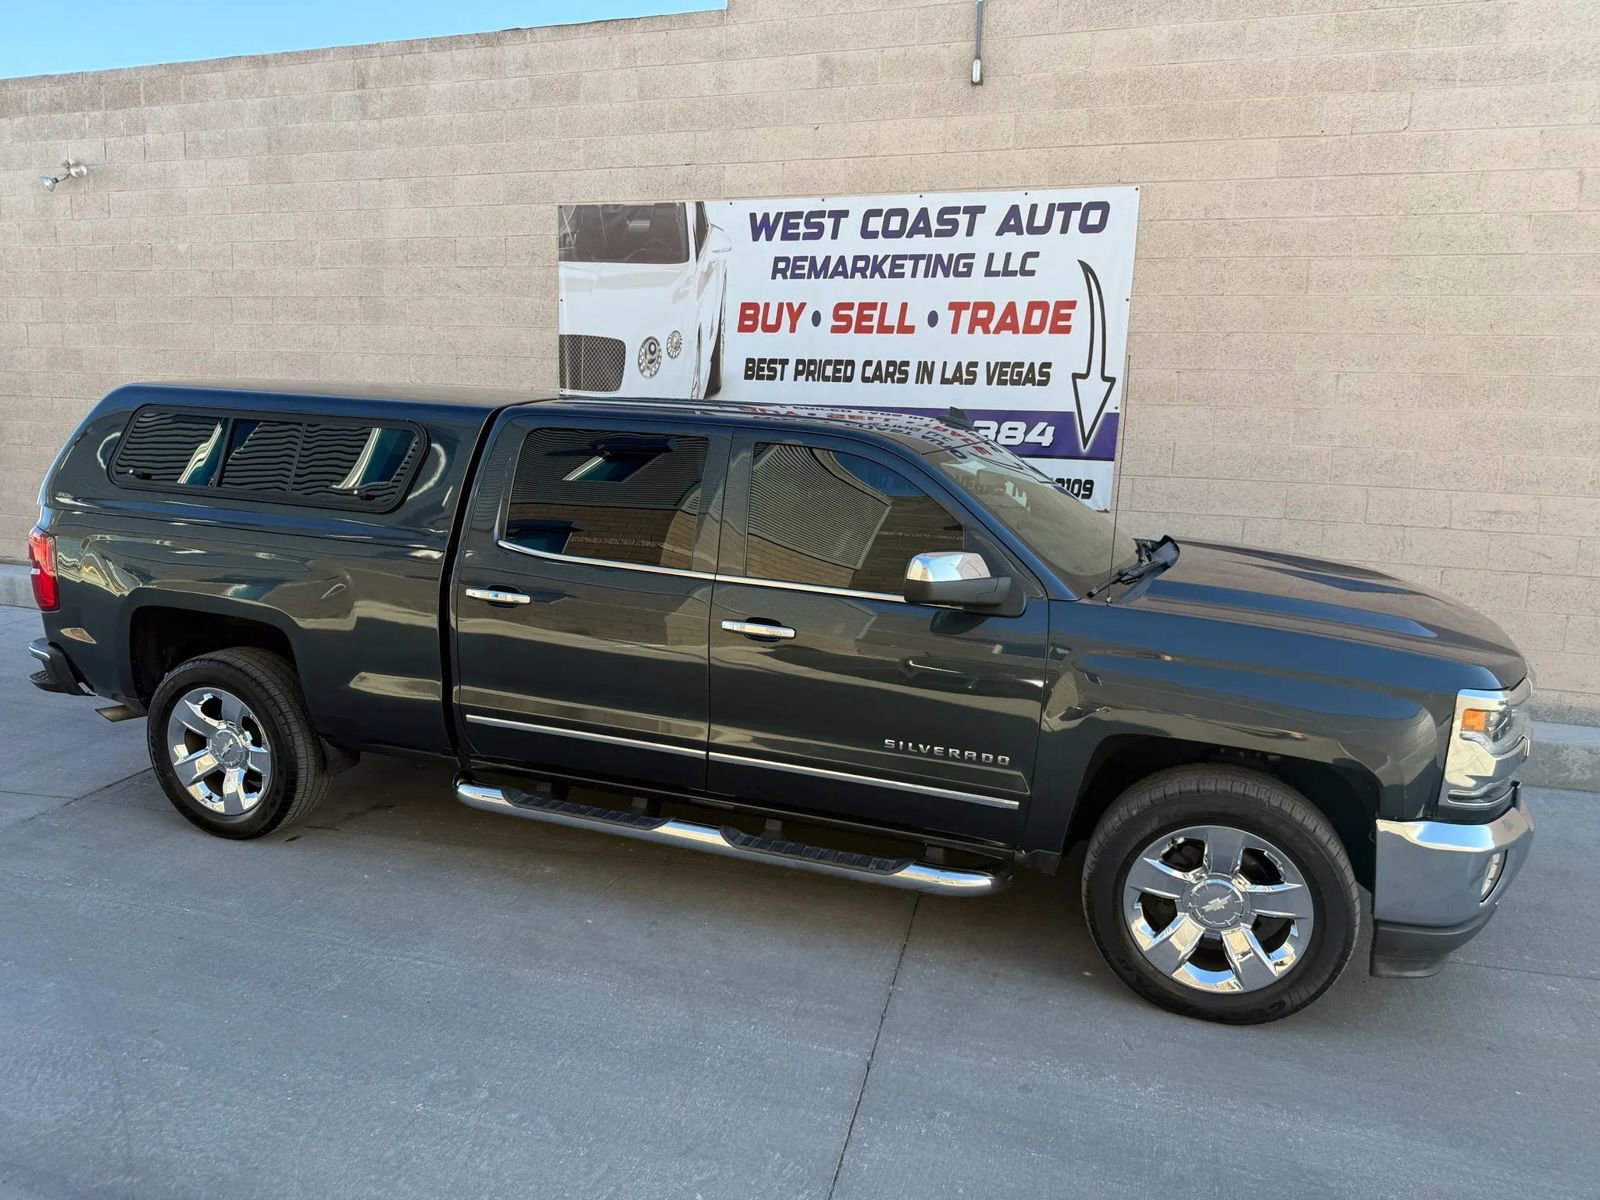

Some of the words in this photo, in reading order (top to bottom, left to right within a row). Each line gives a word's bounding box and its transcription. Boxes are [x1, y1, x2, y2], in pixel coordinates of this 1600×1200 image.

[749, 209, 849, 242] WEST
[859, 205, 986, 240] COAST
[995, 200, 1110, 237] AUTO
[771, 252, 975, 281] REMARKETING
[984, 251, 1040, 278] LLC
[737, 301, 807, 334] BUY
[830, 301, 916, 335] SELL
[947, 300, 1077, 335] TRADE
[743, 357, 789, 382] BEST
[793, 358, 855, 384] PRICED
[860, 359, 910, 385] CARS
[915, 360, 935, 385] IN
[940, 360, 979, 386] LAS
[985, 361, 1053, 387] VEGAS
[973, 420, 1056, 448] 384
[884, 738, 1011, 767] SILVERADO
